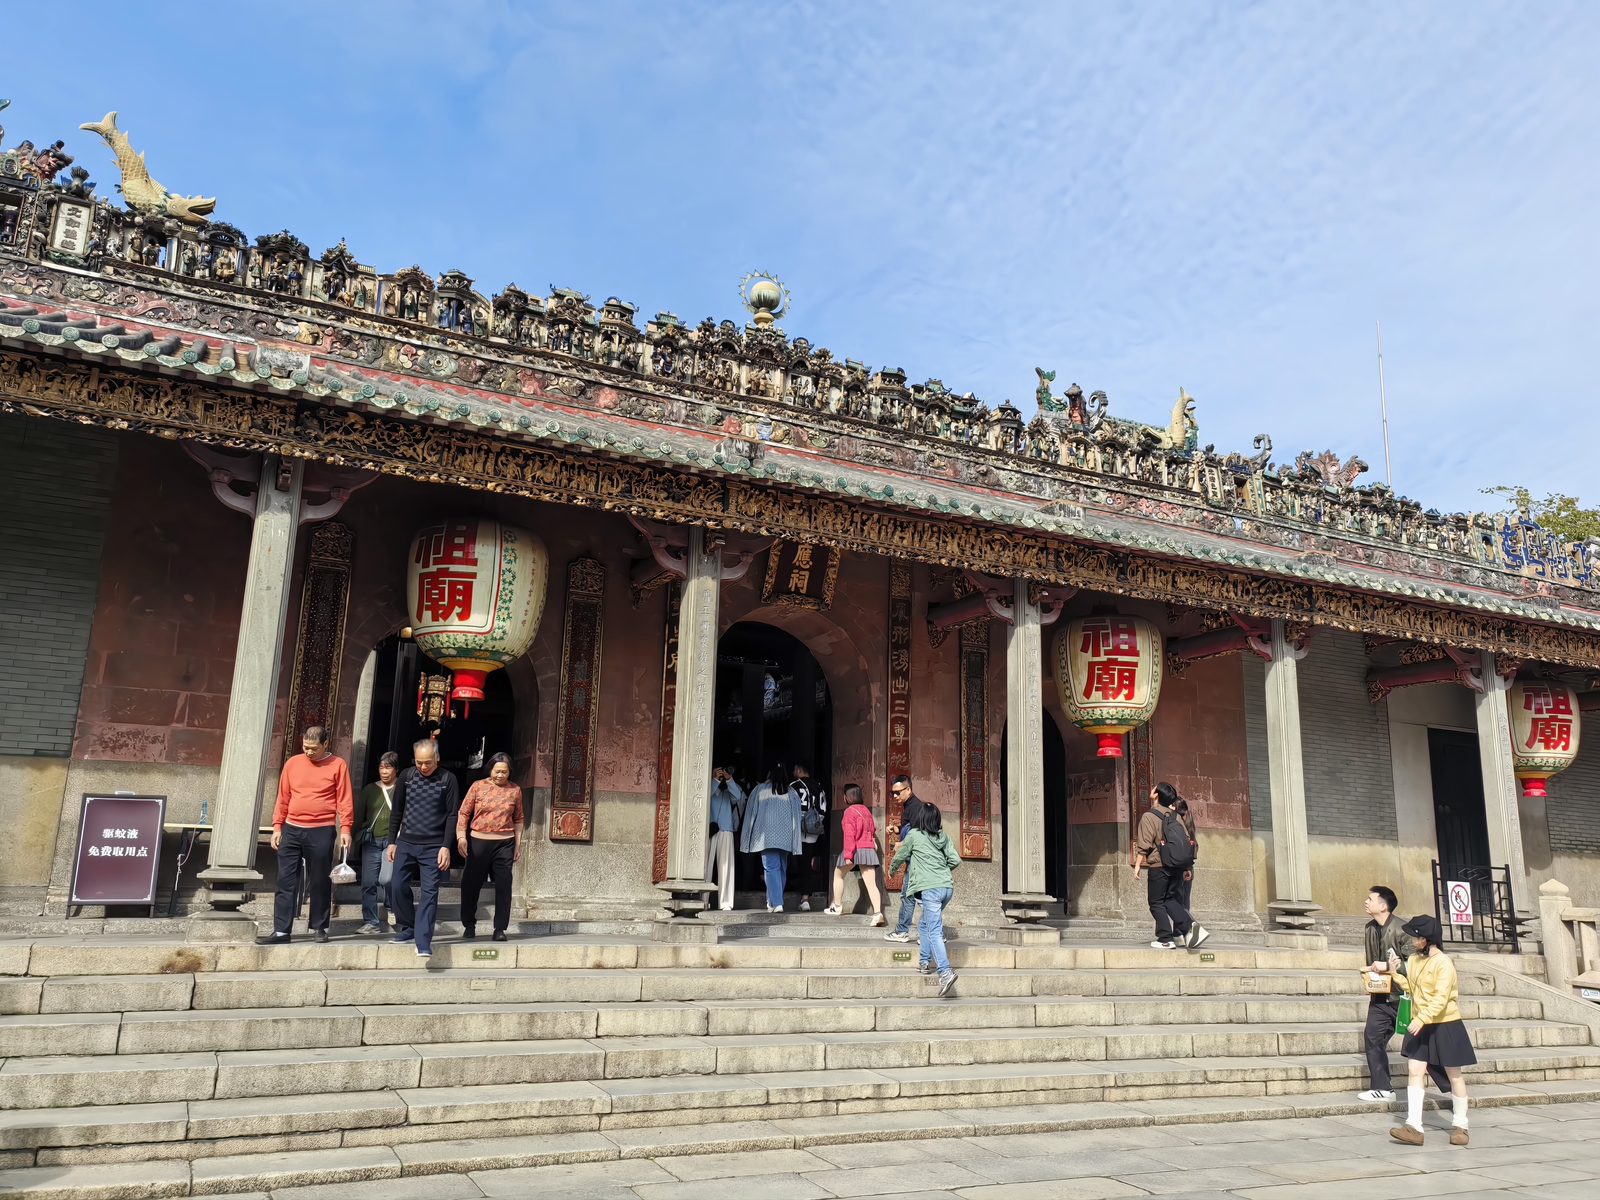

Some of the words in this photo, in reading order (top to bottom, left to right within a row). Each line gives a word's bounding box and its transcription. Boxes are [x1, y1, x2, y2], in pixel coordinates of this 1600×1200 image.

[414, 520, 479, 624] 祖廟
[1080, 618, 1140, 701] 祖廟
[1523, 685, 1573, 752] 祖廟
[88, 846, 149, 857] 免费取用点
